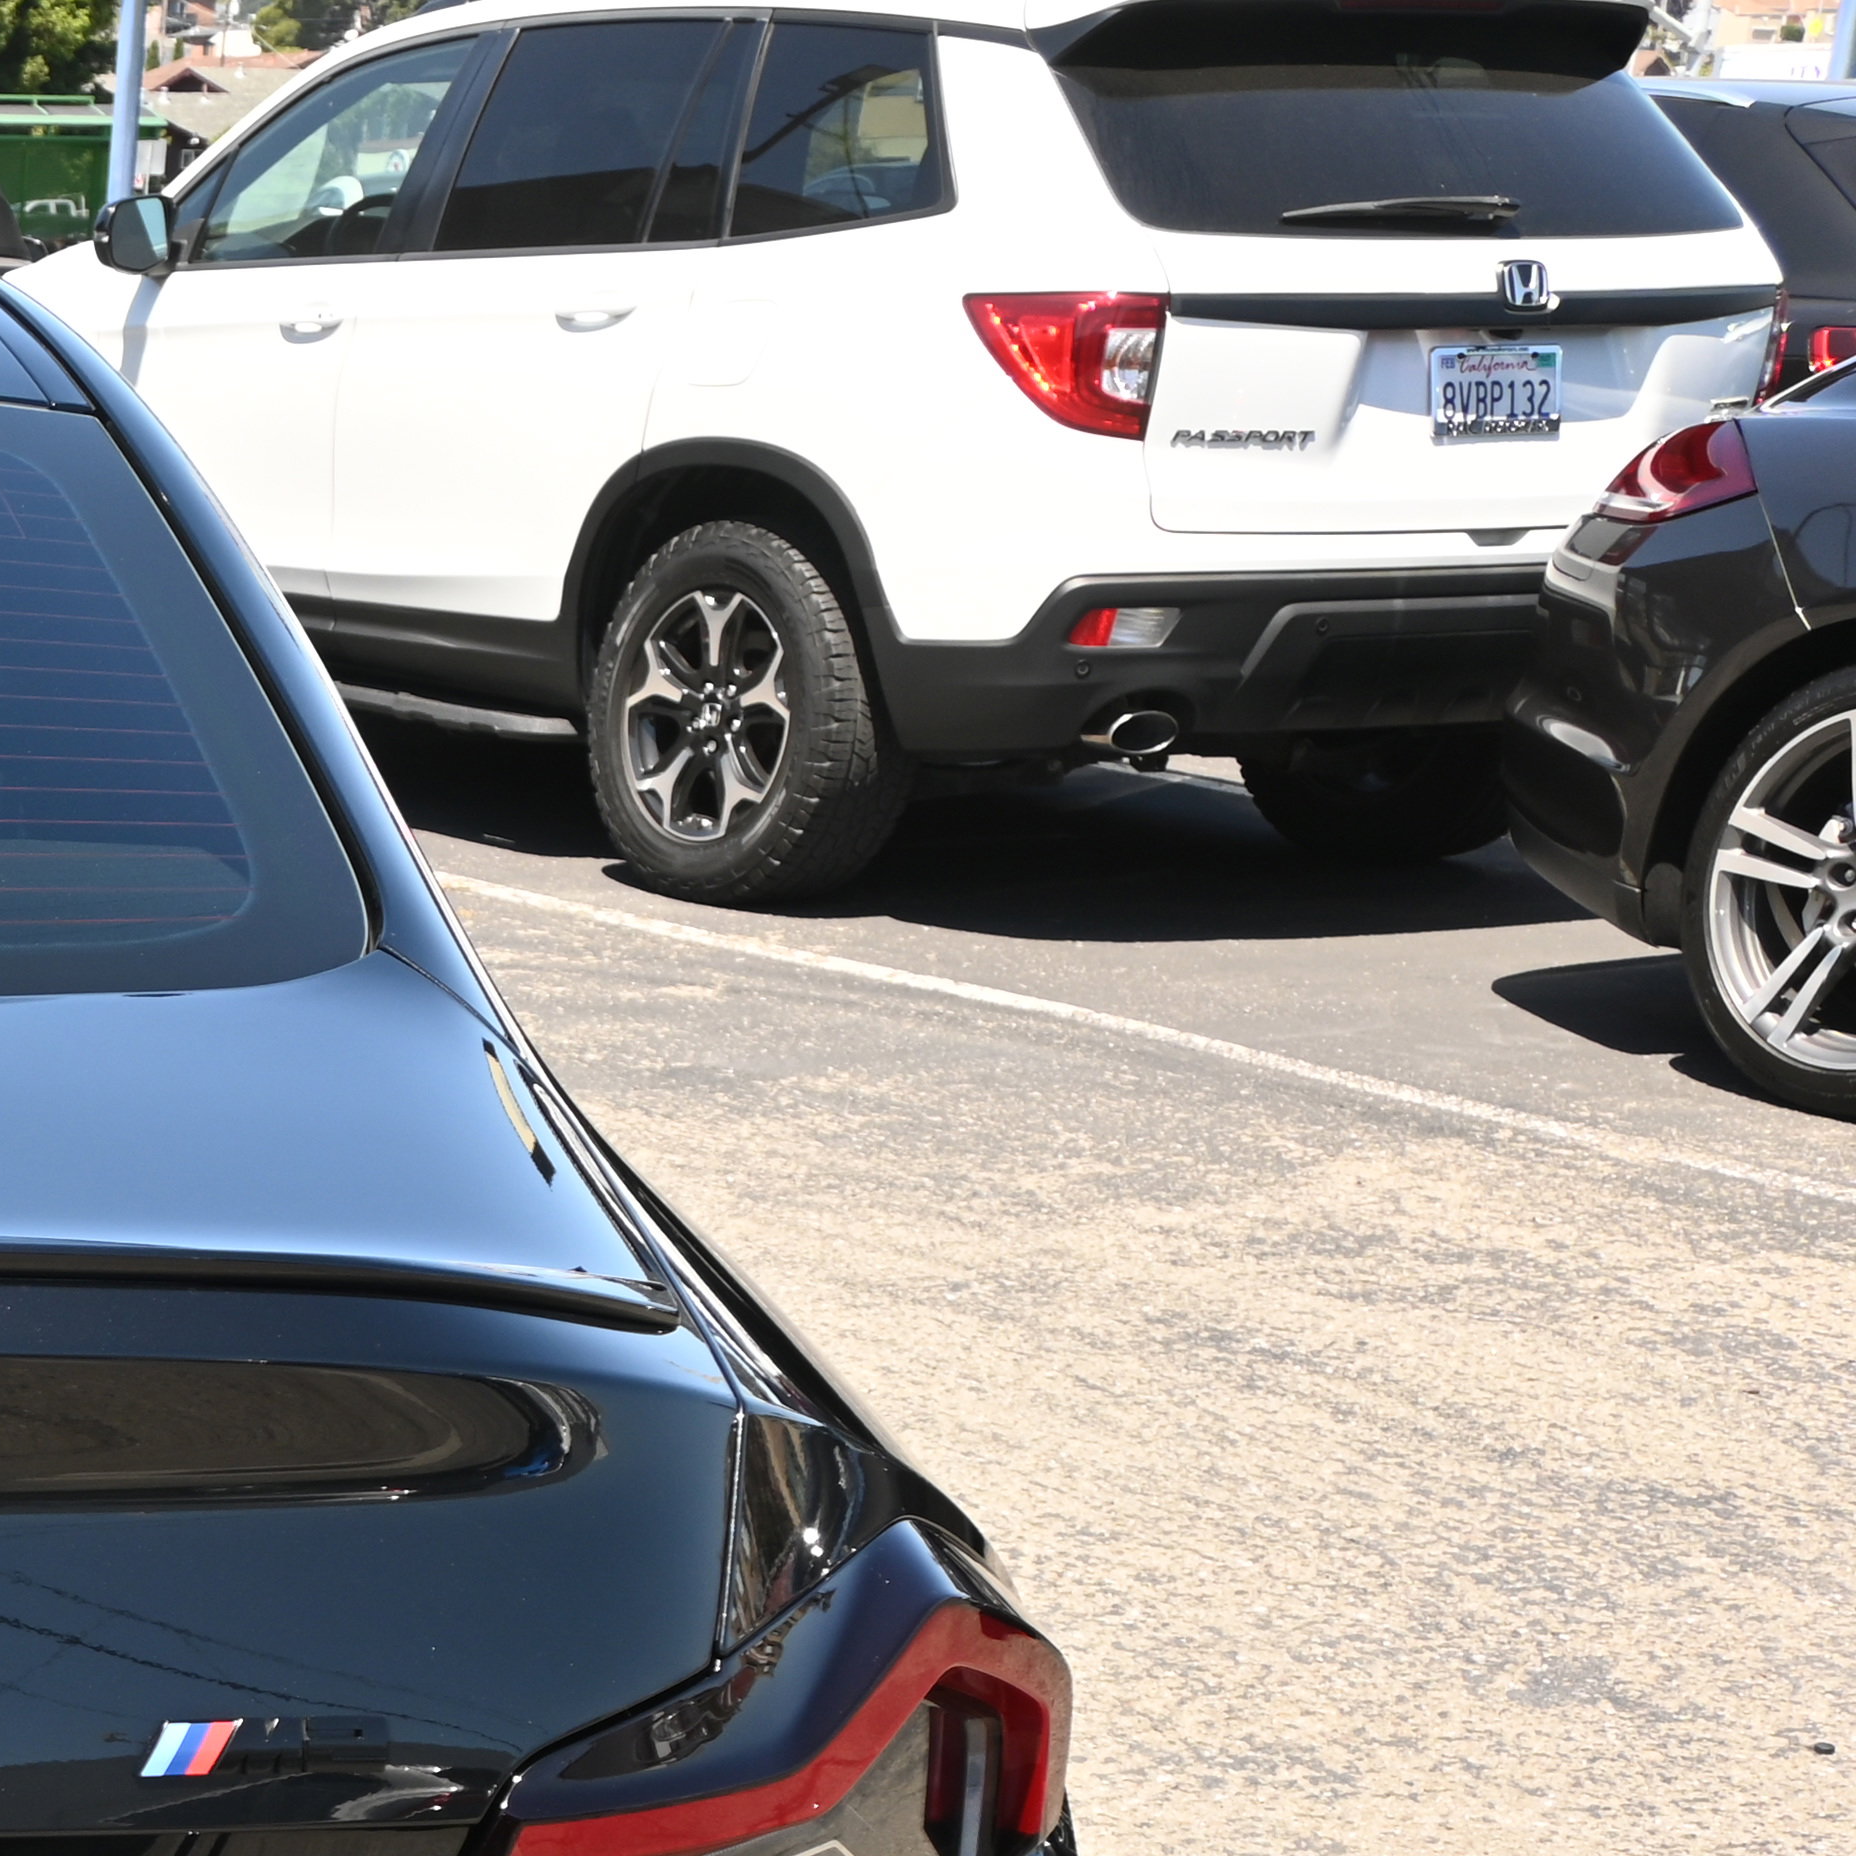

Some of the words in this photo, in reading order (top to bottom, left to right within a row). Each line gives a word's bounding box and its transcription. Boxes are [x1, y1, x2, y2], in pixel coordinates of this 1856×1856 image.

[1458, 354, 1537, 378] California
[1443, 379, 1551, 421] 8VBP132
[1171, 429, 1316, 450] PASSPORT
